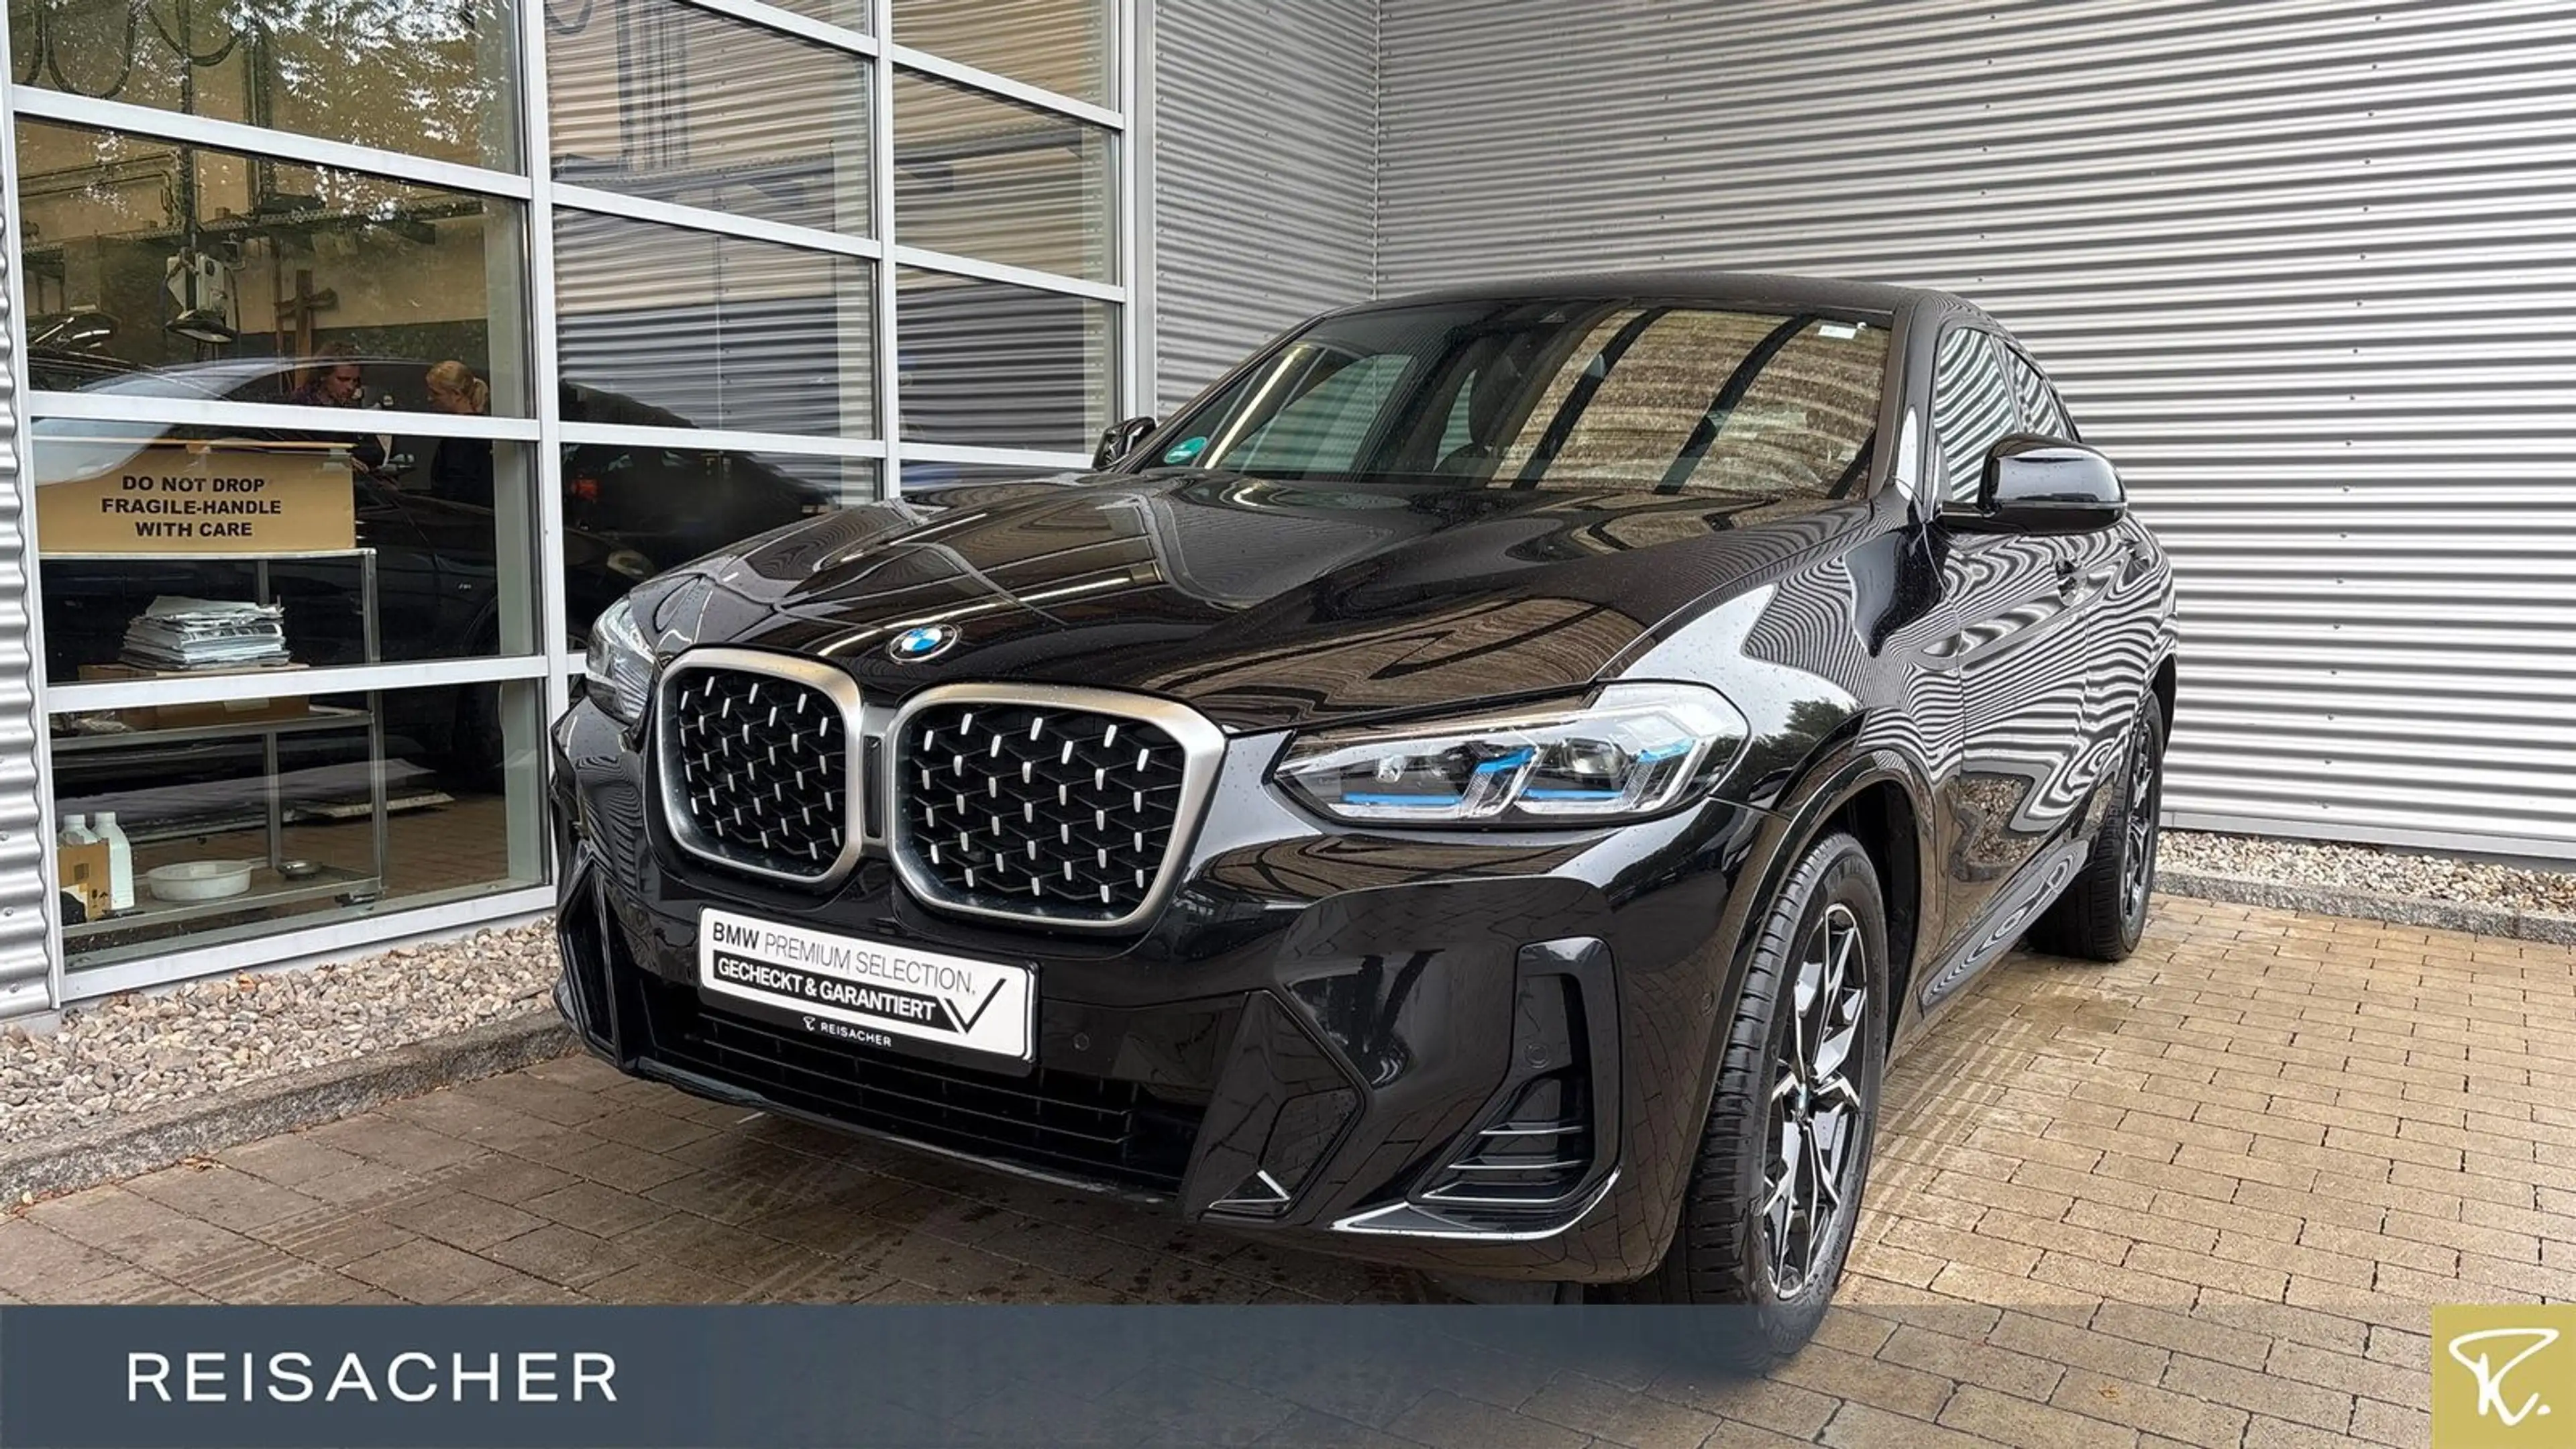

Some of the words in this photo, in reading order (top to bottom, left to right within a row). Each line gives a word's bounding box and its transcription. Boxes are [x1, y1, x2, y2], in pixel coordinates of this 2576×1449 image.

[122, 476, 154, 491] DO
[161, 476, 207, 492] NOT
[212, 478, 265, 492] DROP
[101, 498, 281, 515] FRAGILE-HANDLE
[135, 522, 193, 537] WITH
[199, 522, 252, 536] CARE
[713, 921, 759, 950] BMW
[764, 932, 851, 972] PREMIUM
[718, 957, 804, 993] GECHECKT
[804, 977, 817, 997] &
[819, 981, 936, 1021] GARANTIERT
[820, 1022, 892, 1047] REISACHER
